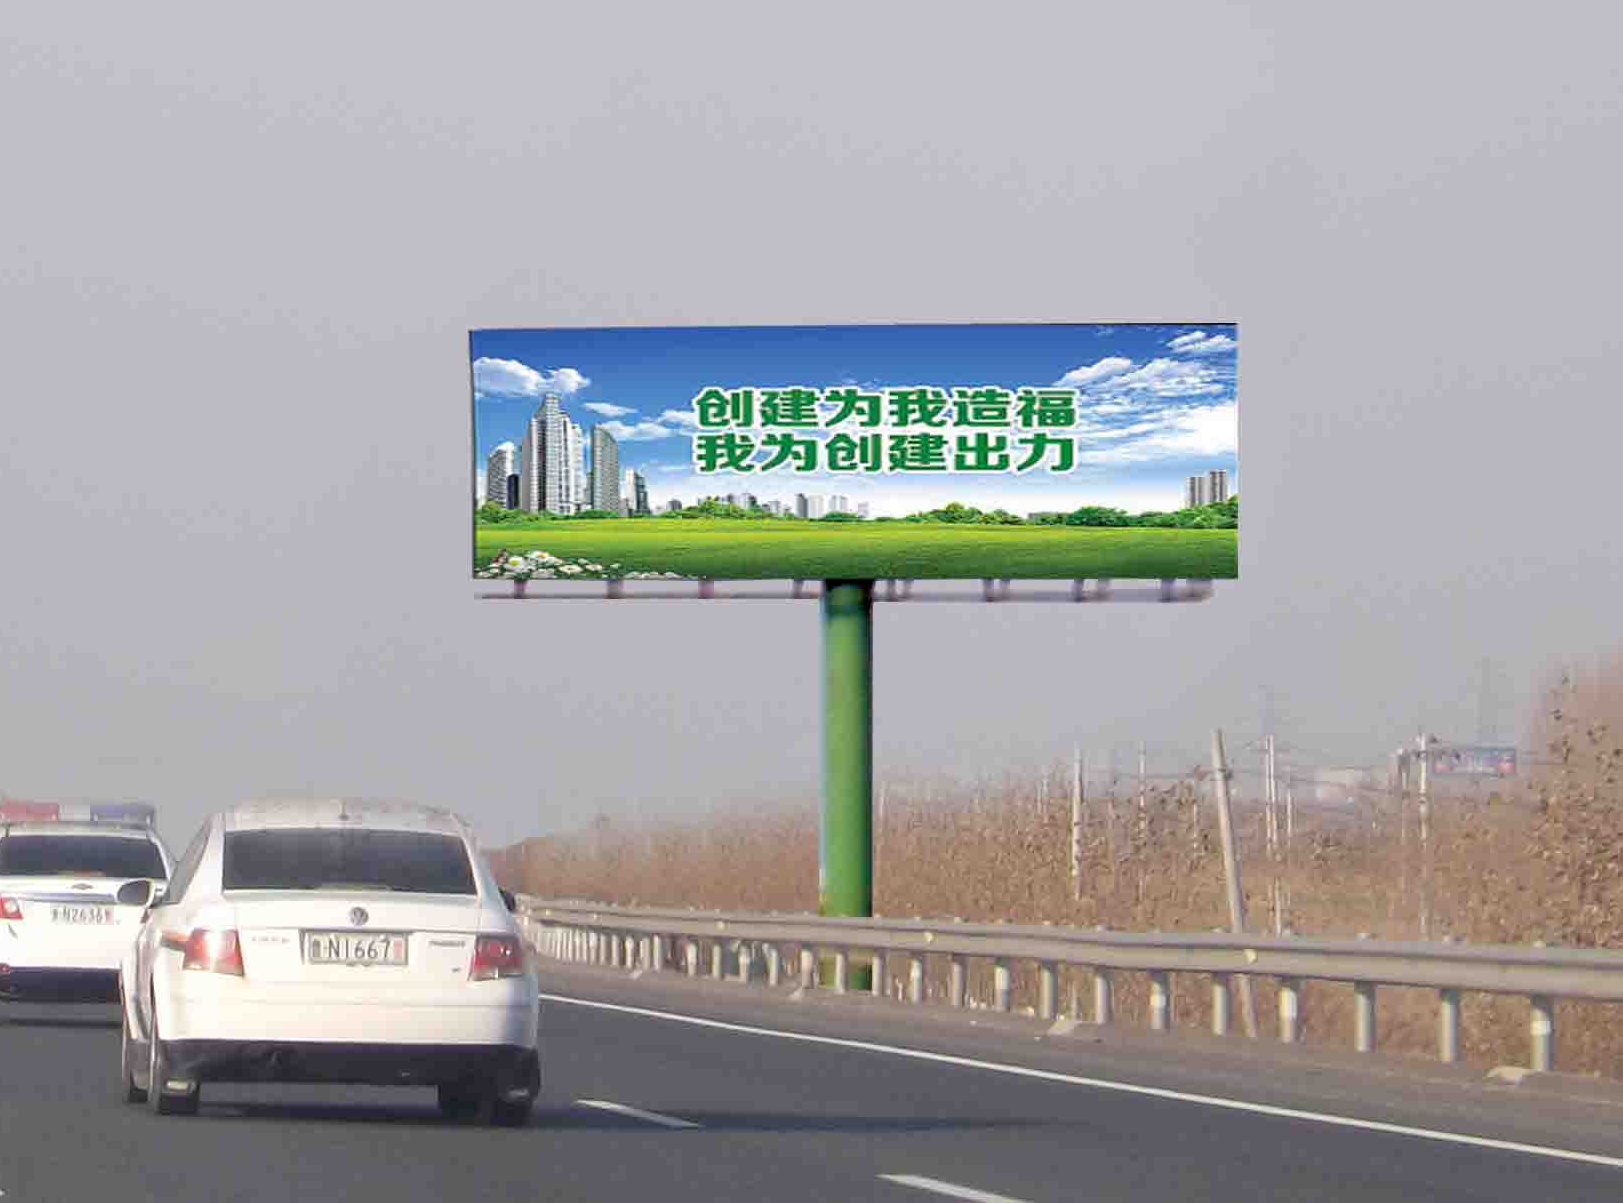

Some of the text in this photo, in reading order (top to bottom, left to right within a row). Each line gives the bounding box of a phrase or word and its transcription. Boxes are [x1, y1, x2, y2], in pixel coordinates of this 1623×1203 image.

[696, 388, 1077, 429] 创建为我造福
[696, 432, 1077, 474] 我为创建出力
[312, 937, 404, 959] N1667
